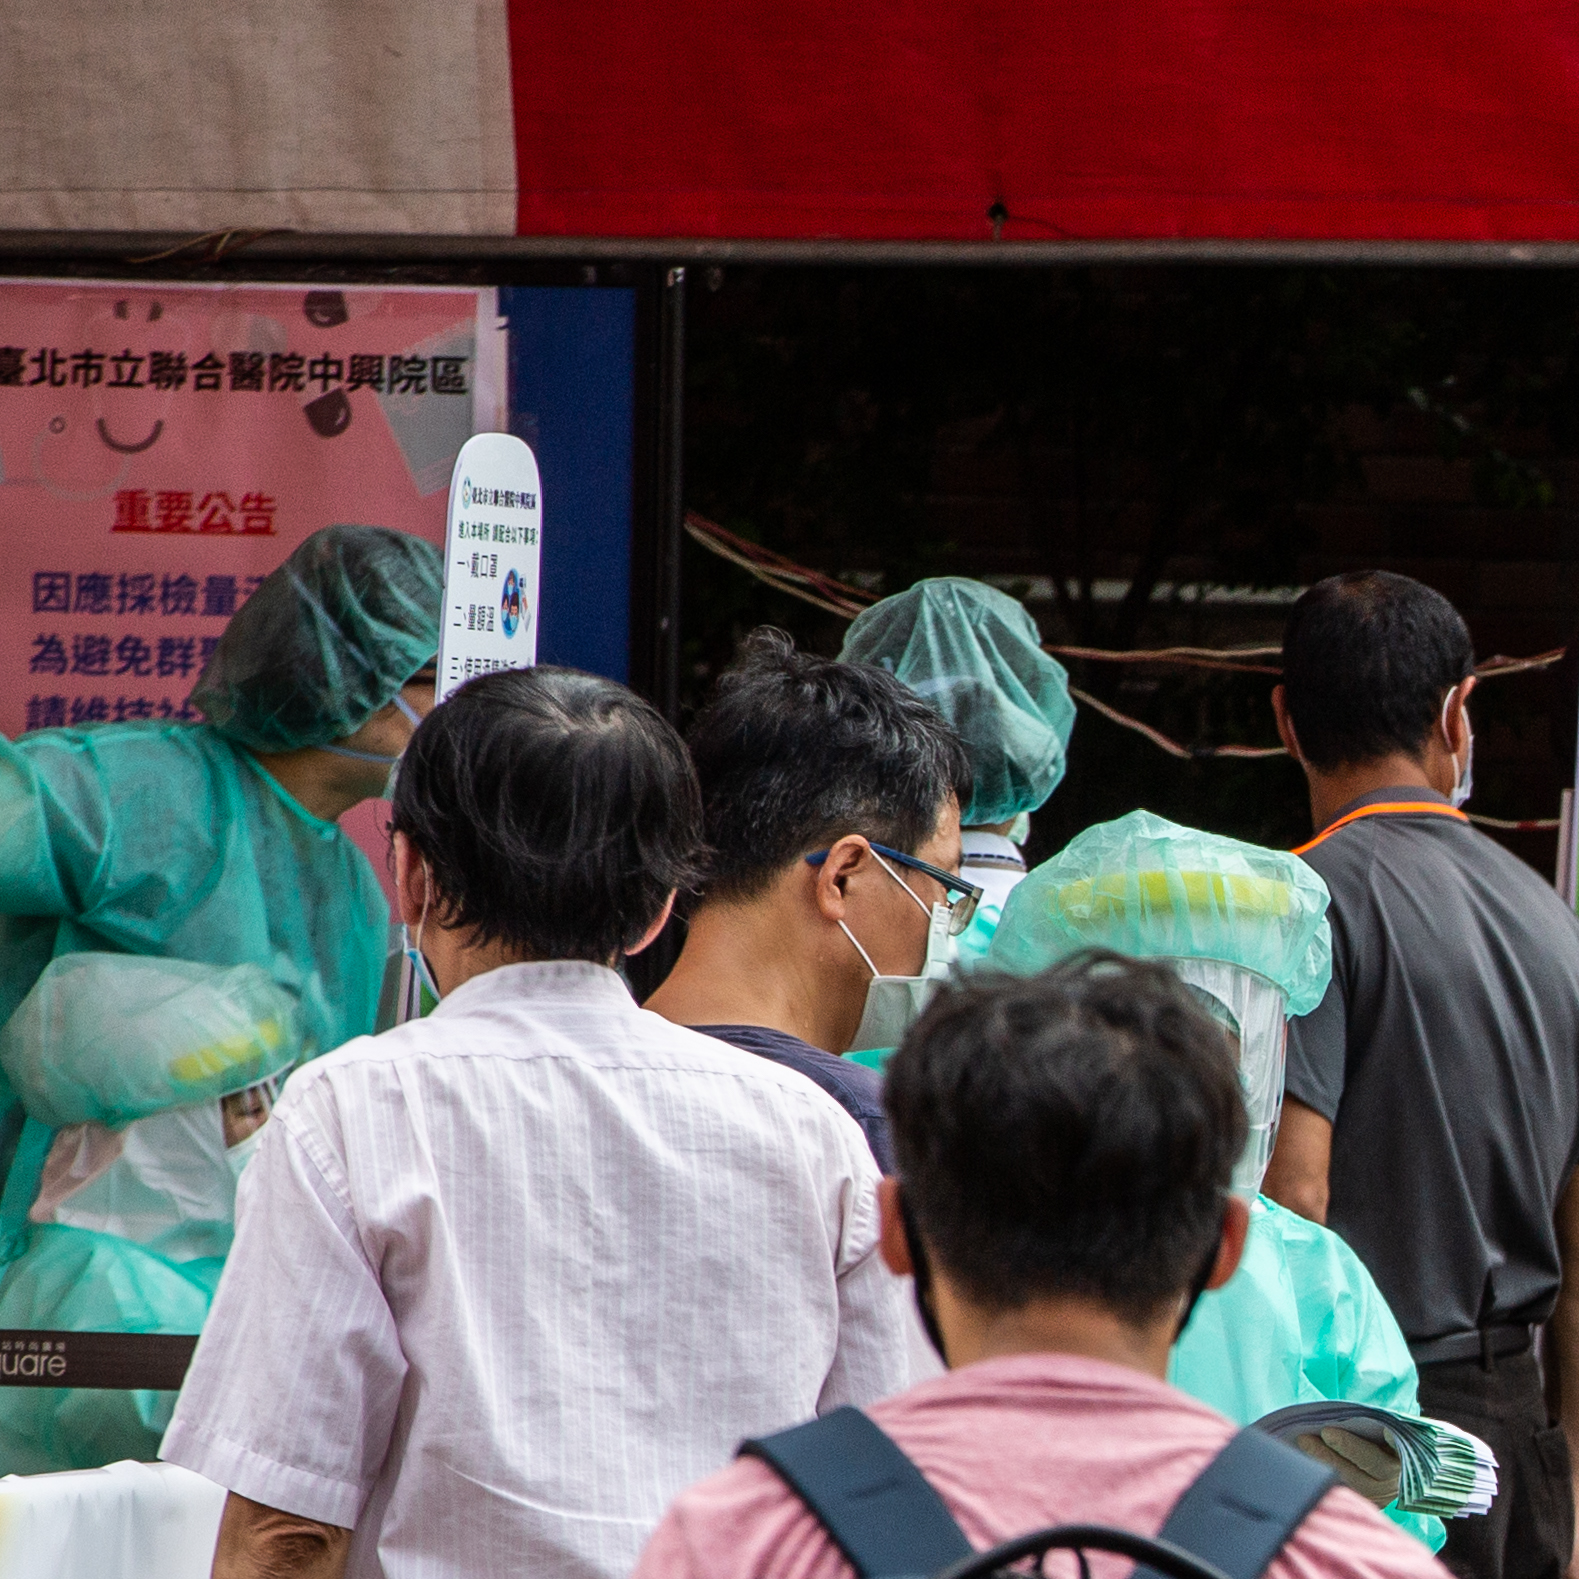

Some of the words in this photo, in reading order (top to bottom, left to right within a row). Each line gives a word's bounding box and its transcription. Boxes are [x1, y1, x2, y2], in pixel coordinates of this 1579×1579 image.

[111, 489, 278, 536] 重要公告
[0, 1353, 67, 1377] uare
